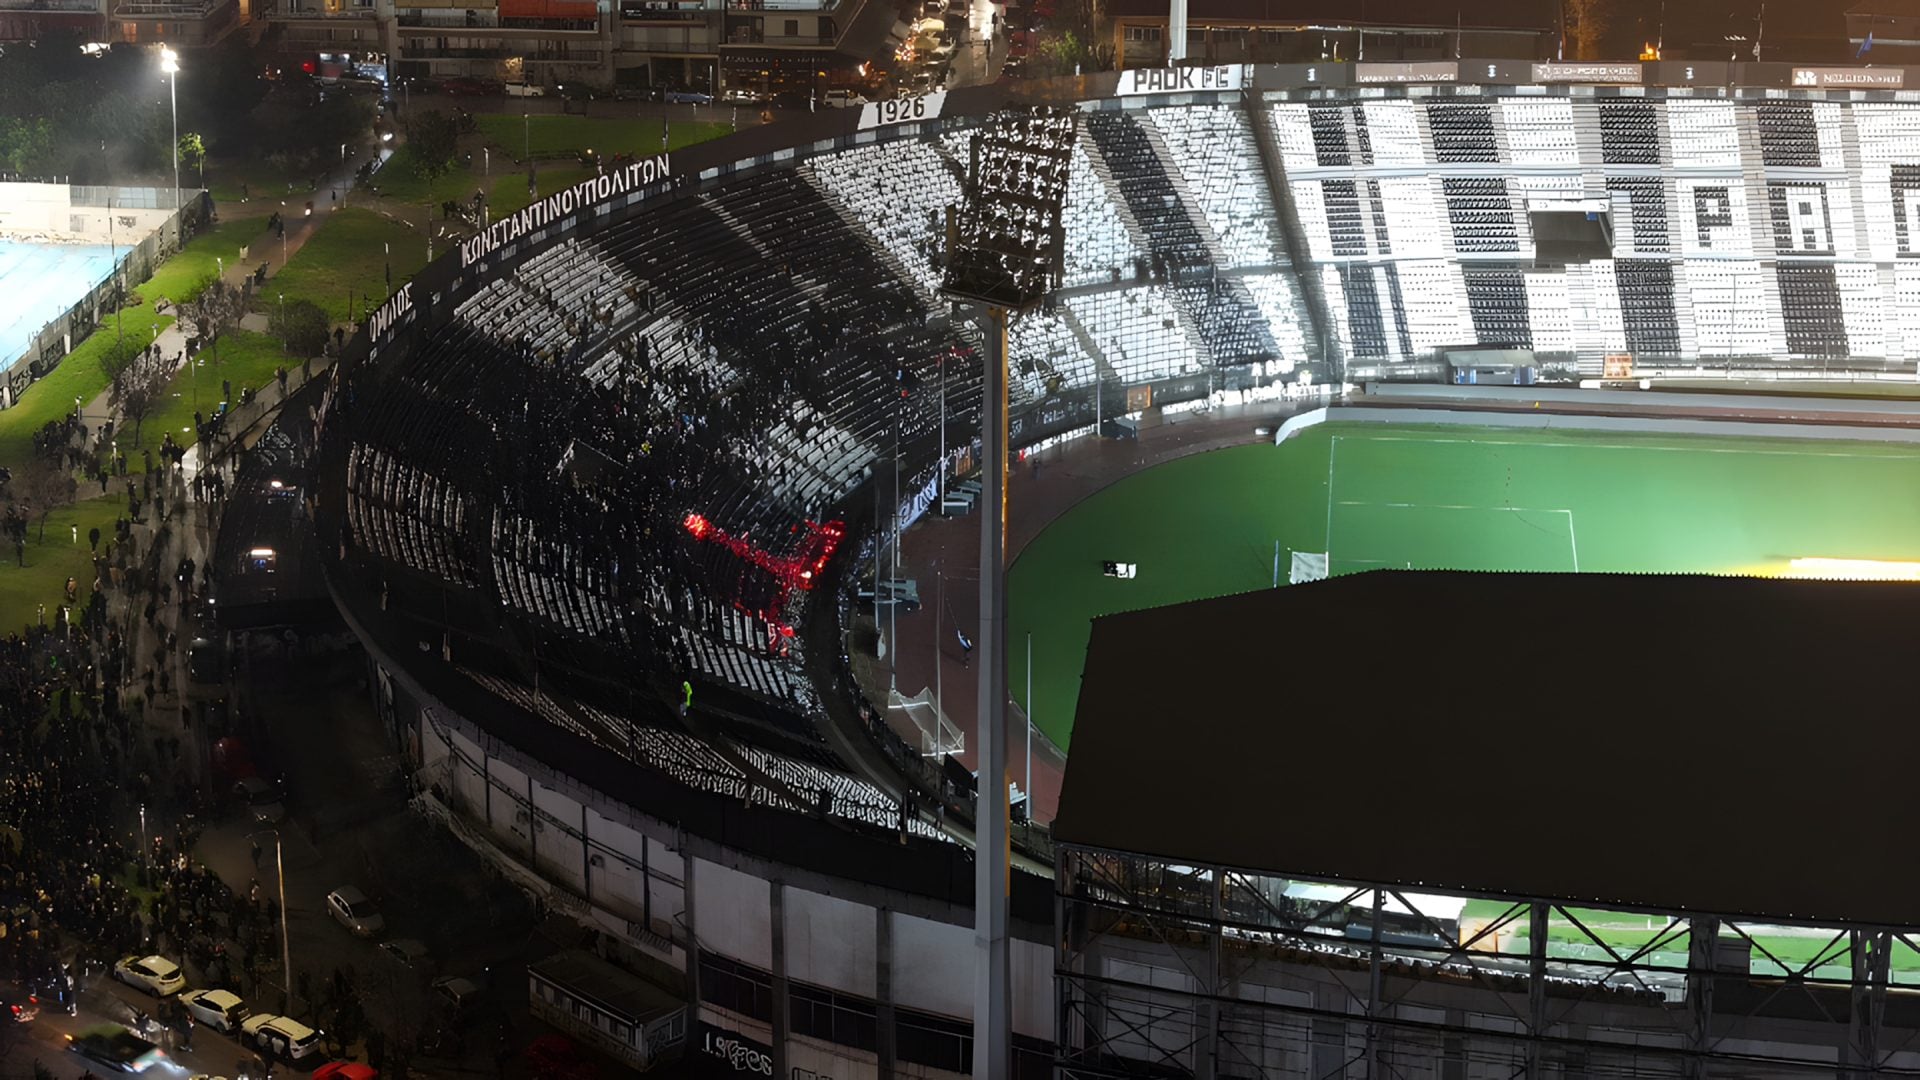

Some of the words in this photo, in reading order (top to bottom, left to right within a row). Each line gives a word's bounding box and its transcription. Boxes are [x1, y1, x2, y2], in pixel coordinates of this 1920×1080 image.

[1133, 66, 1195, 93] PAOK
[875, 96, 925, 124] 1926
[461, 152, 671, 269] ΚΩΝΣΤΑΝΤΙΝΟΥΠΟΛΙΤΩΝ
